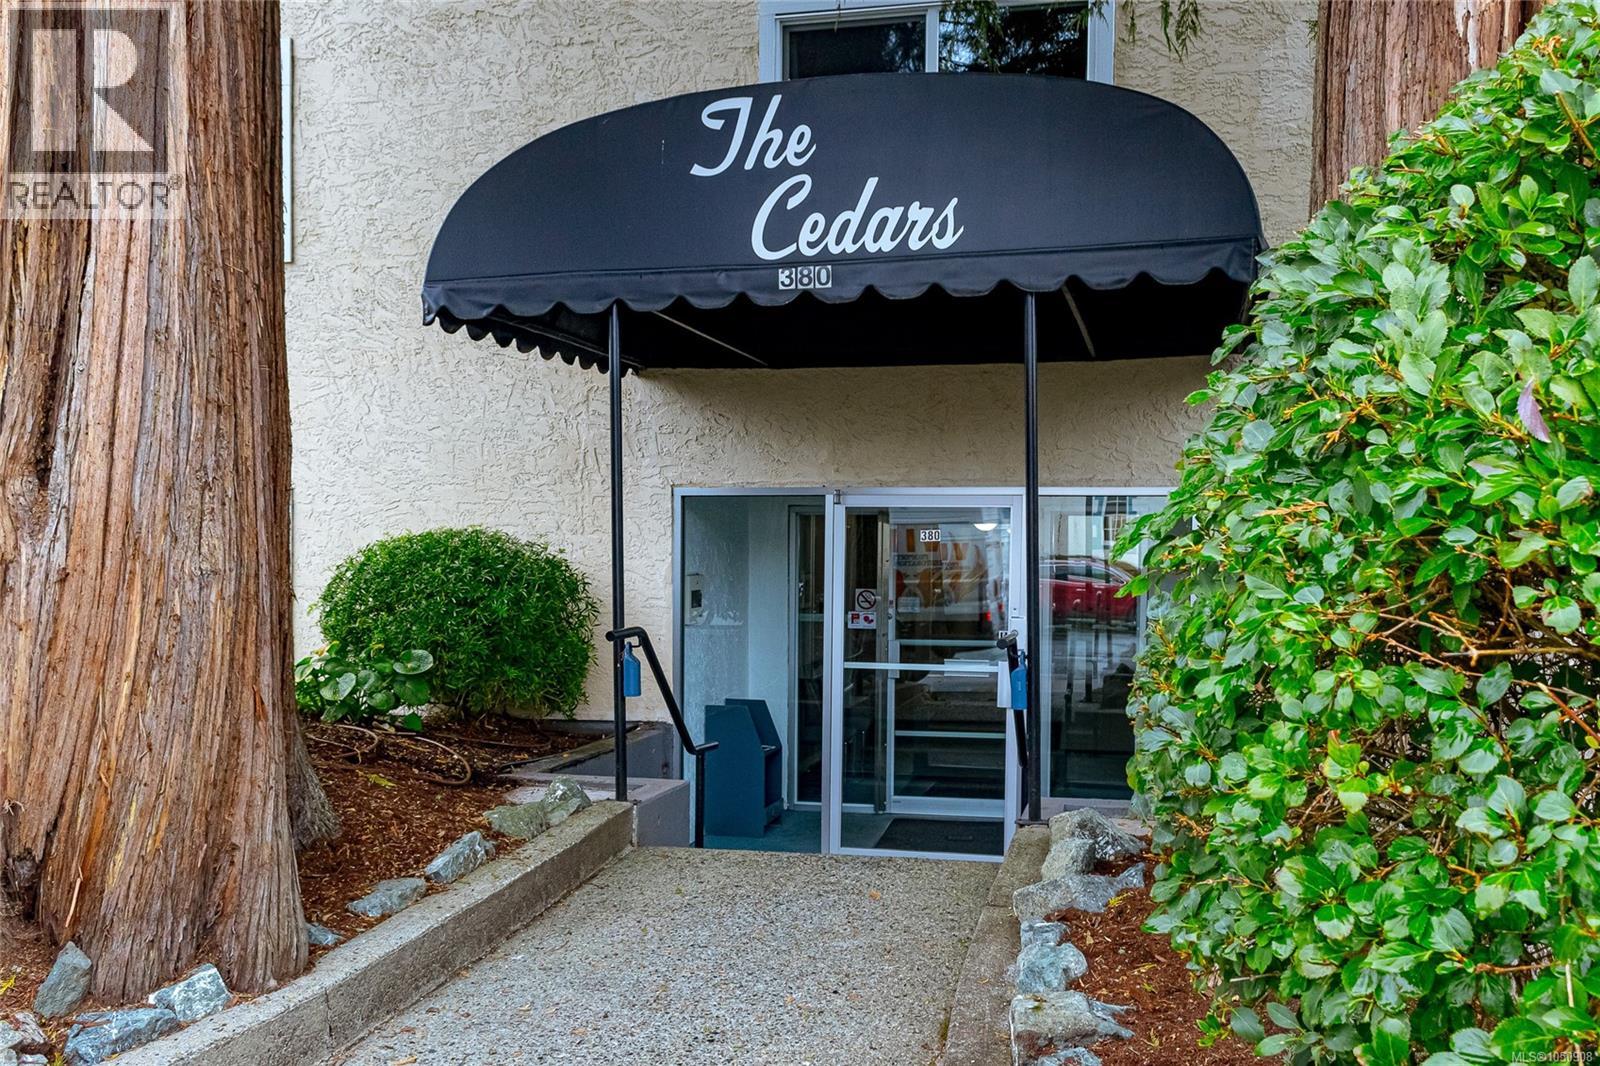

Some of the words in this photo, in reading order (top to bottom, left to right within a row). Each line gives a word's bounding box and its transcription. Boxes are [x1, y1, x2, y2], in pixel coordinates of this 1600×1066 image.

[690, 94, 816, 177] The
[751, 174, 964, 261] Cedars
[779, 266, 832, 289] 380
[920, 530, 940, 541] 380
